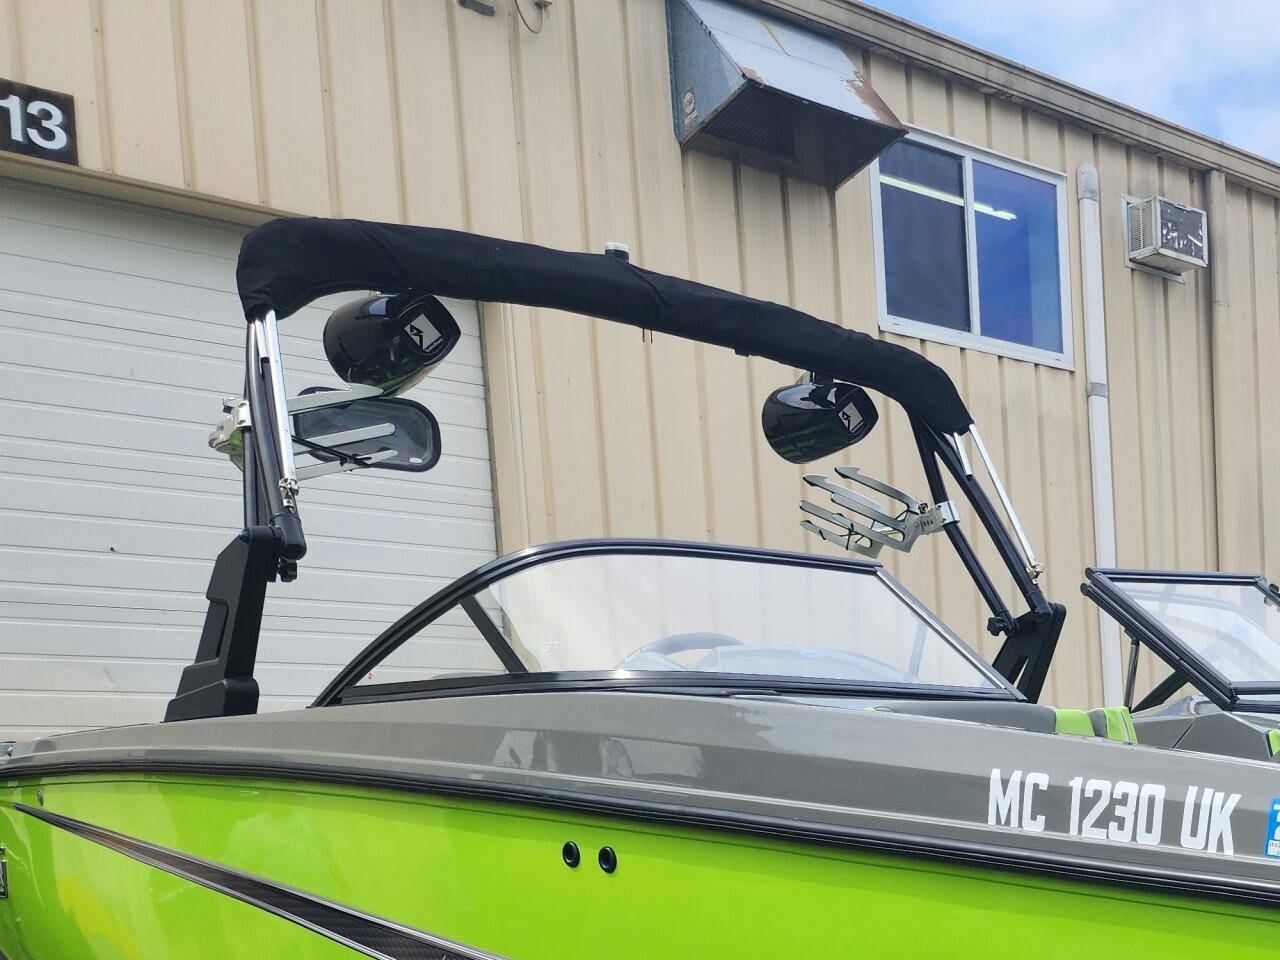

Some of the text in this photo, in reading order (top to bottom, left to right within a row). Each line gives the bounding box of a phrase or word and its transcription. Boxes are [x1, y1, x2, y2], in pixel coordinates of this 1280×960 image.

[0, 94, 67, 150] 13
[987, 768, 1242, 856] MC 1230 UK
